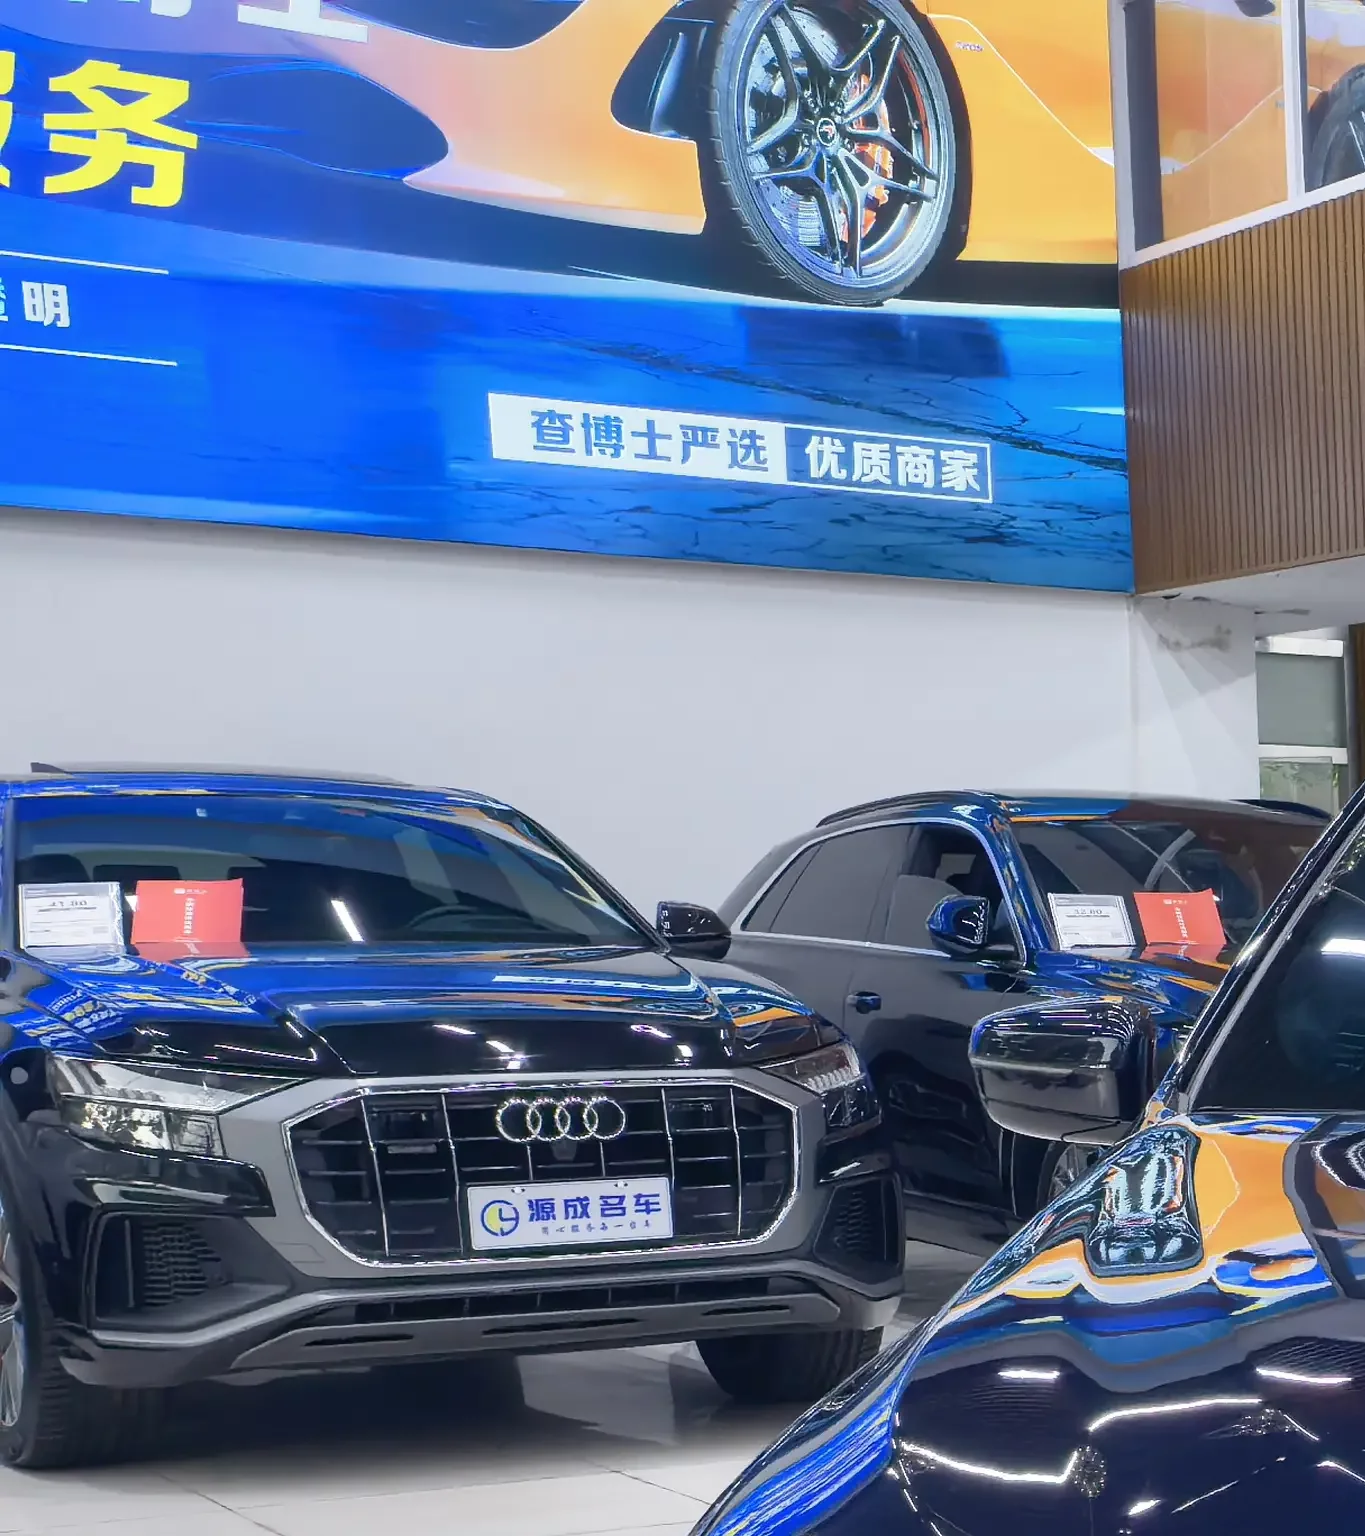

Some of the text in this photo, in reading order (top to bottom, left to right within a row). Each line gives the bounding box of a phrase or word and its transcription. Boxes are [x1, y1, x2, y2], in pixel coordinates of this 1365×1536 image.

[0, 50, 198, 207] 务
[0, 277, 71, 327] 明
[530, 409, 982, 493] 查博士严选 优质商家
[528, 1193, 662, 1222] 源成名车
